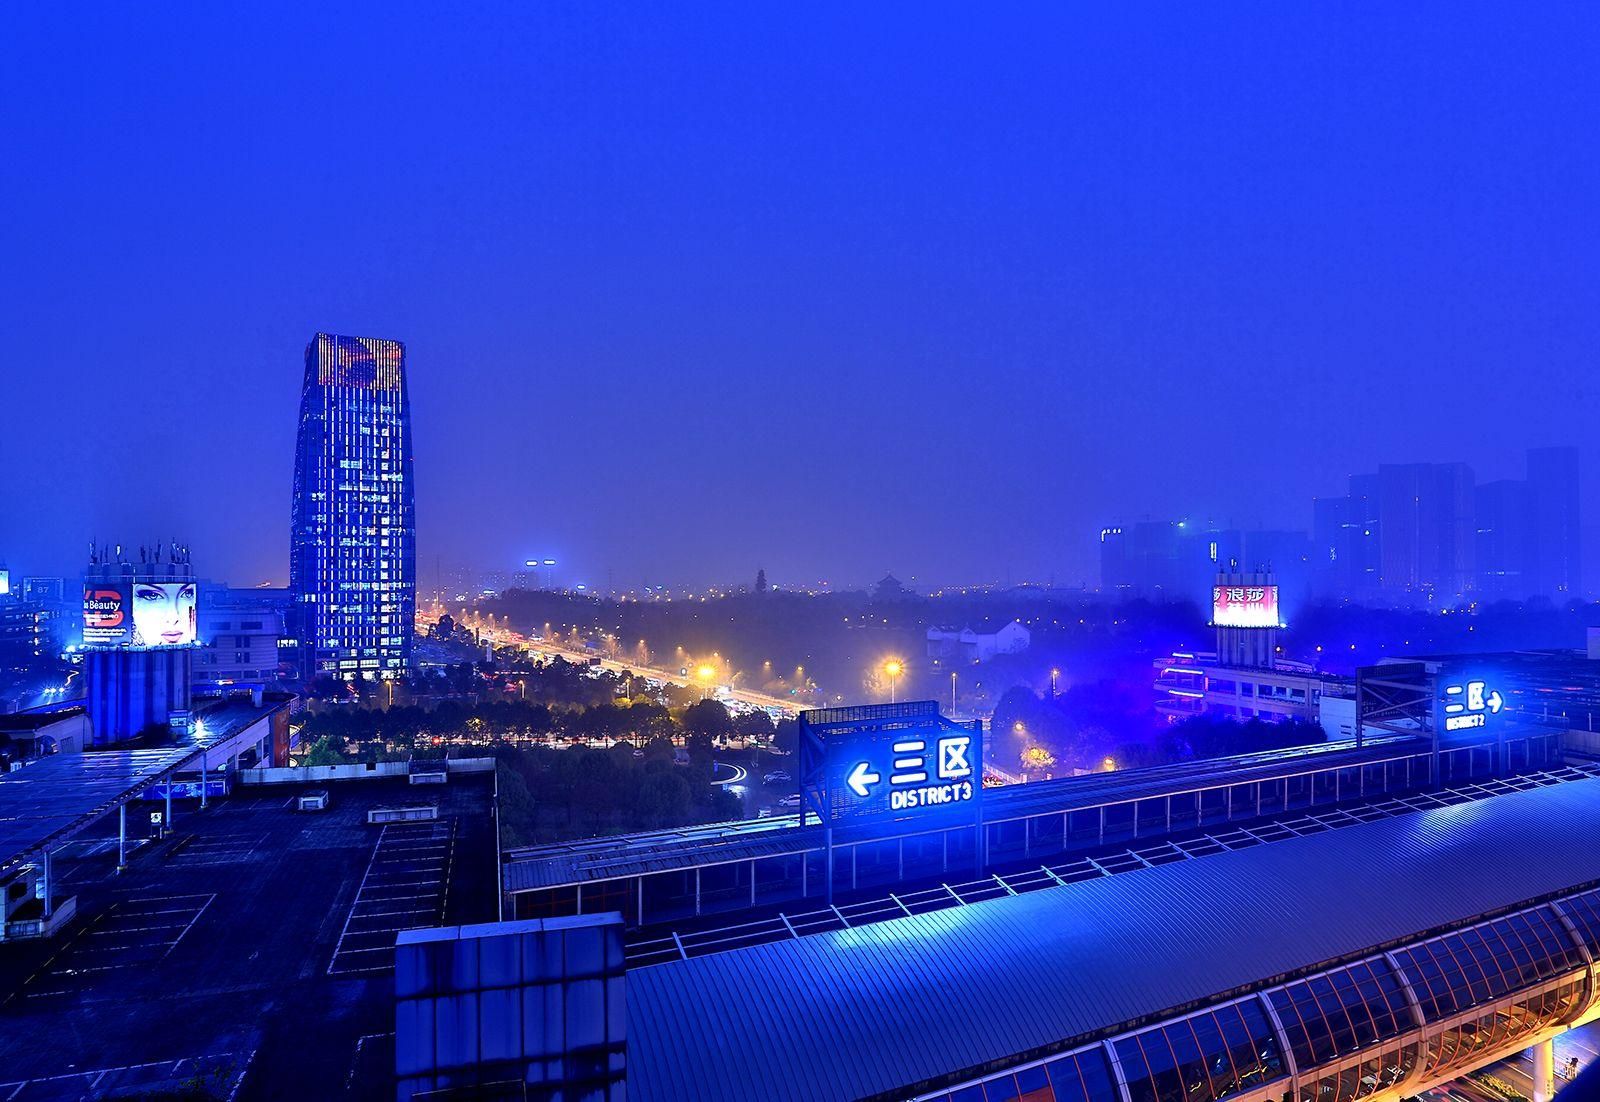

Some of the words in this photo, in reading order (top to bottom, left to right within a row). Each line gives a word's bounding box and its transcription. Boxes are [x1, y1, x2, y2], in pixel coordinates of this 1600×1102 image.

[1227, 587, 1265, 603] 浪莎
[1445, 682, 1485, 713] 二区
[891, 737, 971, 784] 三区
